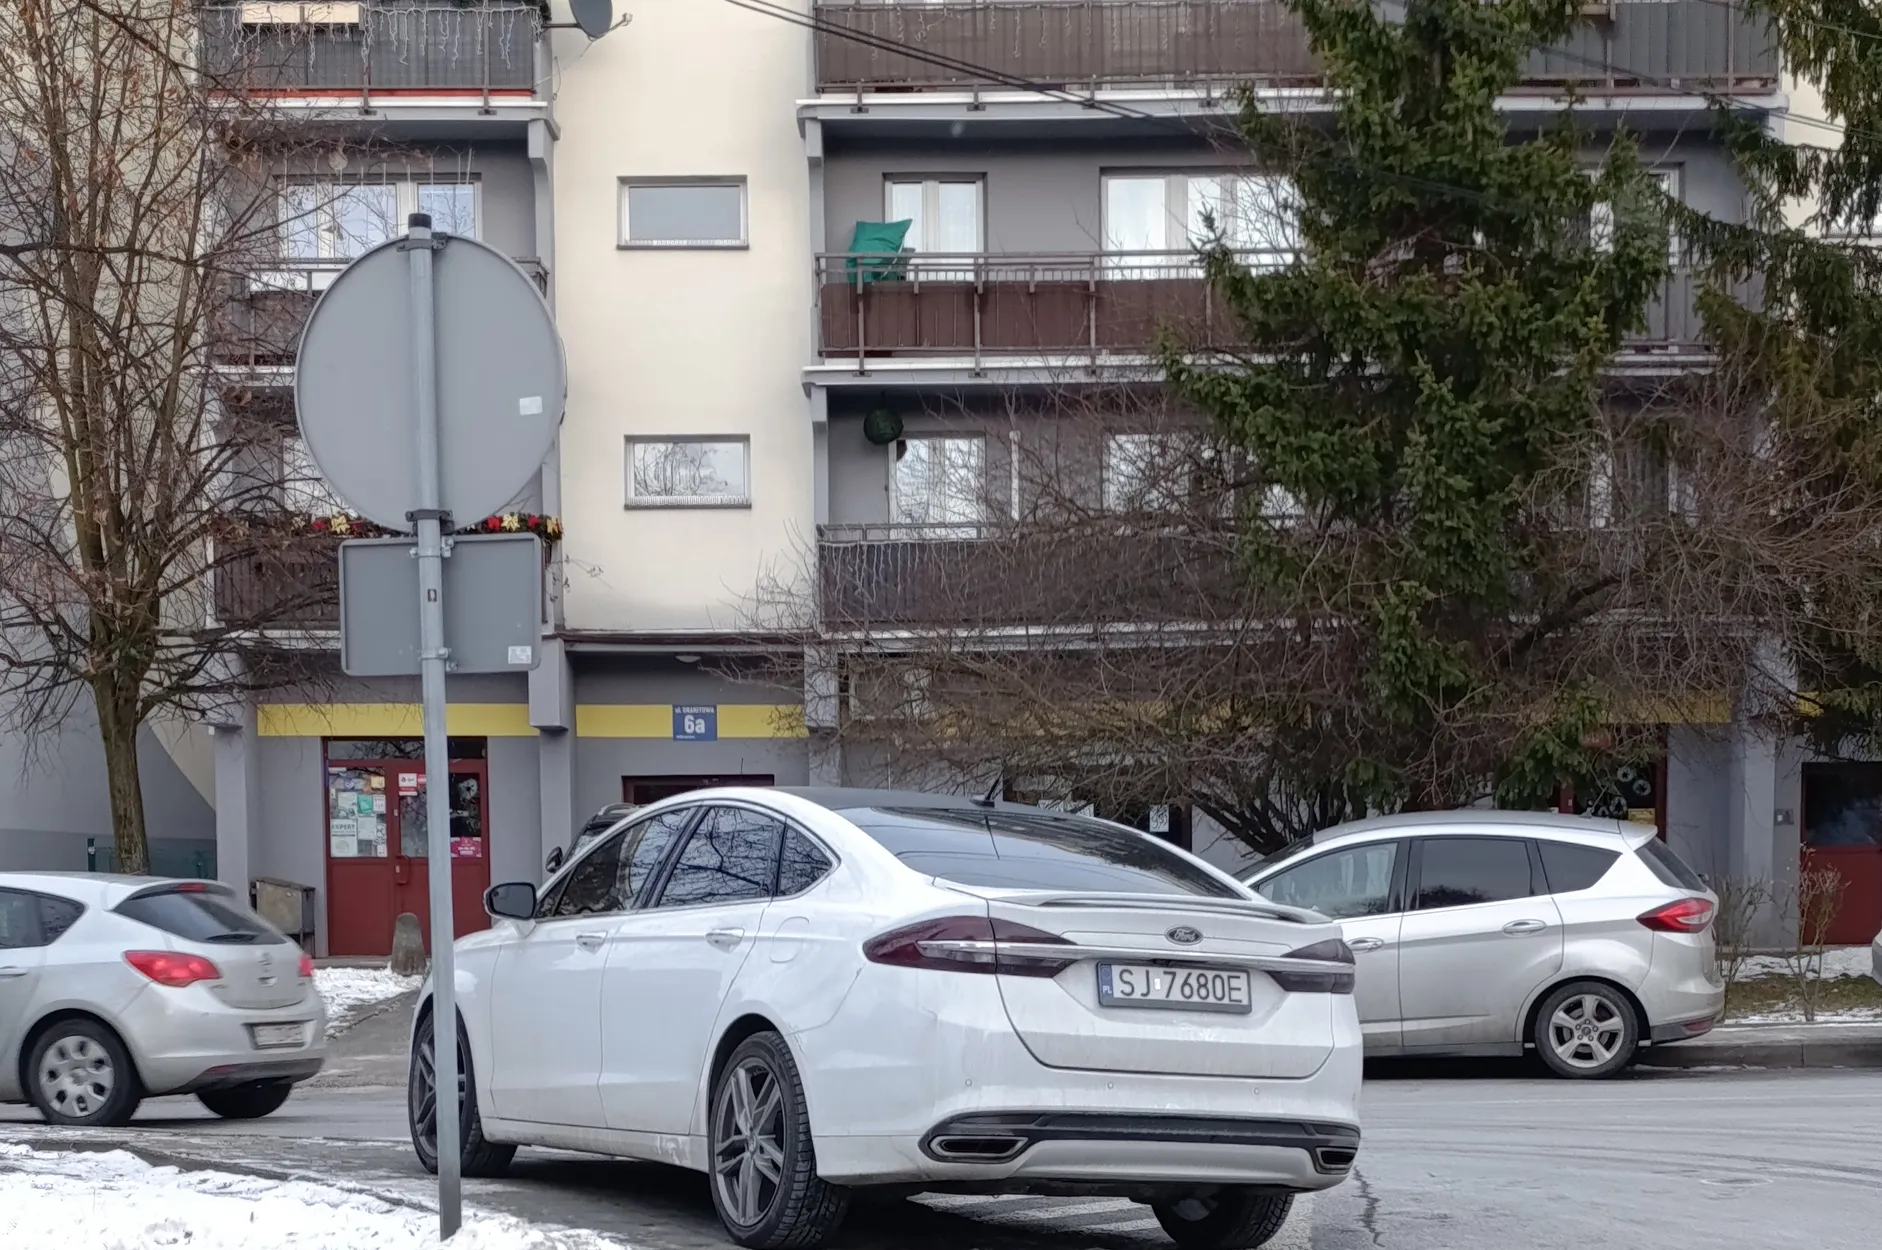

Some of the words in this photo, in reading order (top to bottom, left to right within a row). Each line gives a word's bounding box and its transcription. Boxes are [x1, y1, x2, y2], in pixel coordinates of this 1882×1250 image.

[684, 714, 706, 734] 6a
[1173, 928, 1197, 942] Ford
[1102, 985, 1113, 994] PL
[1118, 968, 1151, 998] SJ
[1162, 970, 1243, 1003] 7680E
